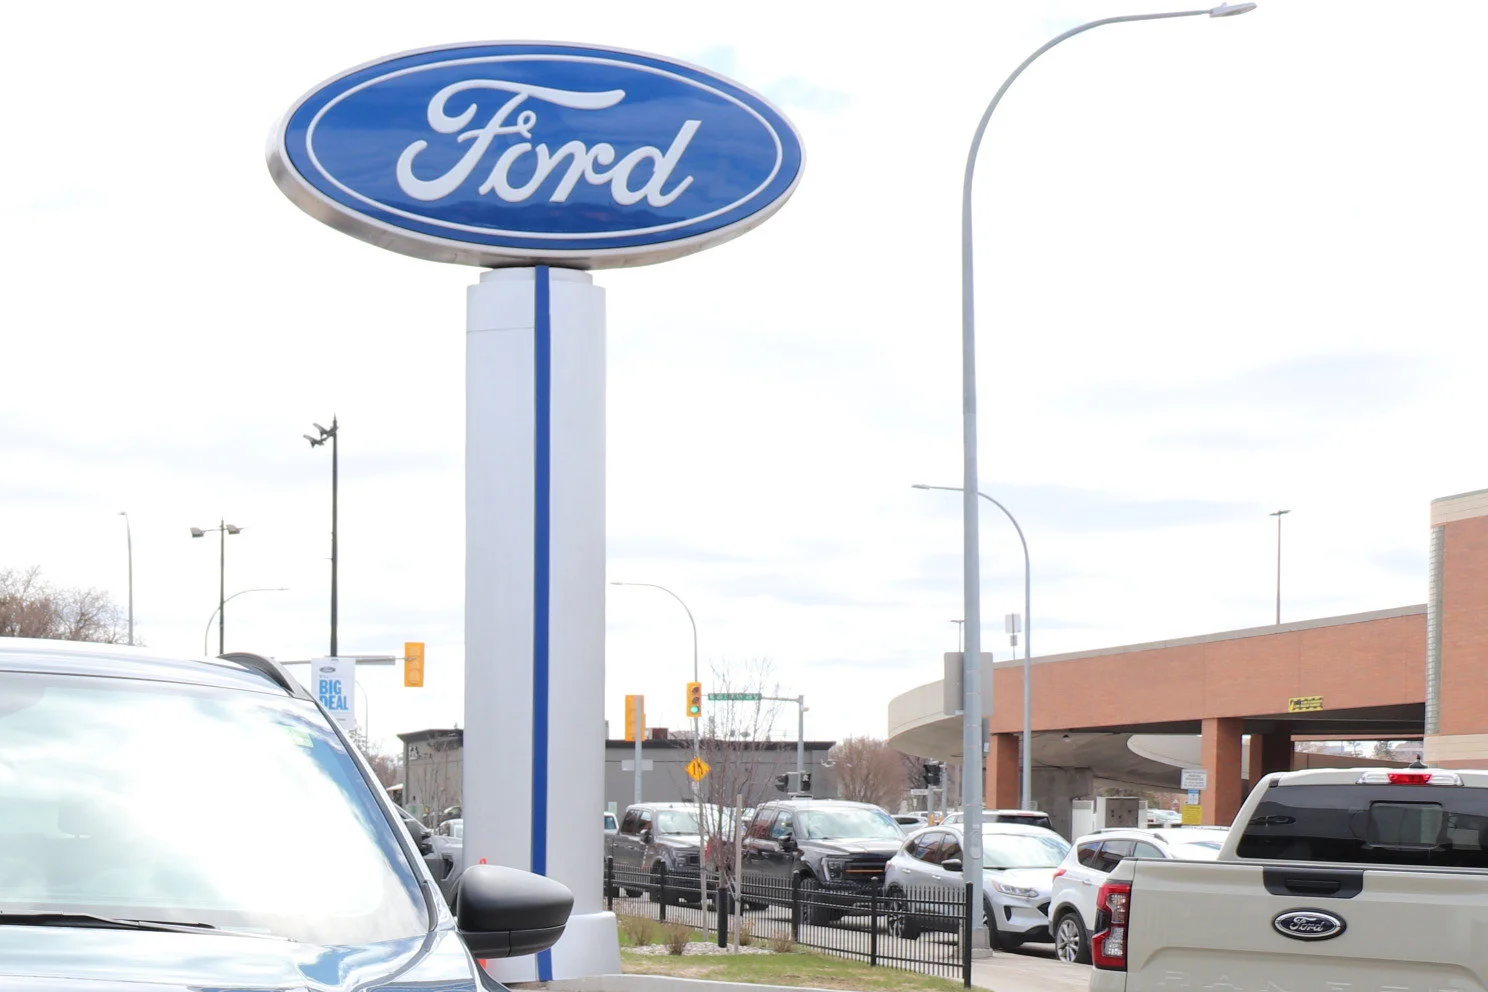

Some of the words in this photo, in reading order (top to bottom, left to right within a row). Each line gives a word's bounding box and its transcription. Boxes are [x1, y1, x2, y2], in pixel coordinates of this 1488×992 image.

[396, 79, 702, 208] Ford
[319, 679, 342, 695] BIG
[319, 695, 349, 710] DEAL
[1289, 916, 1325, 932] Ford
